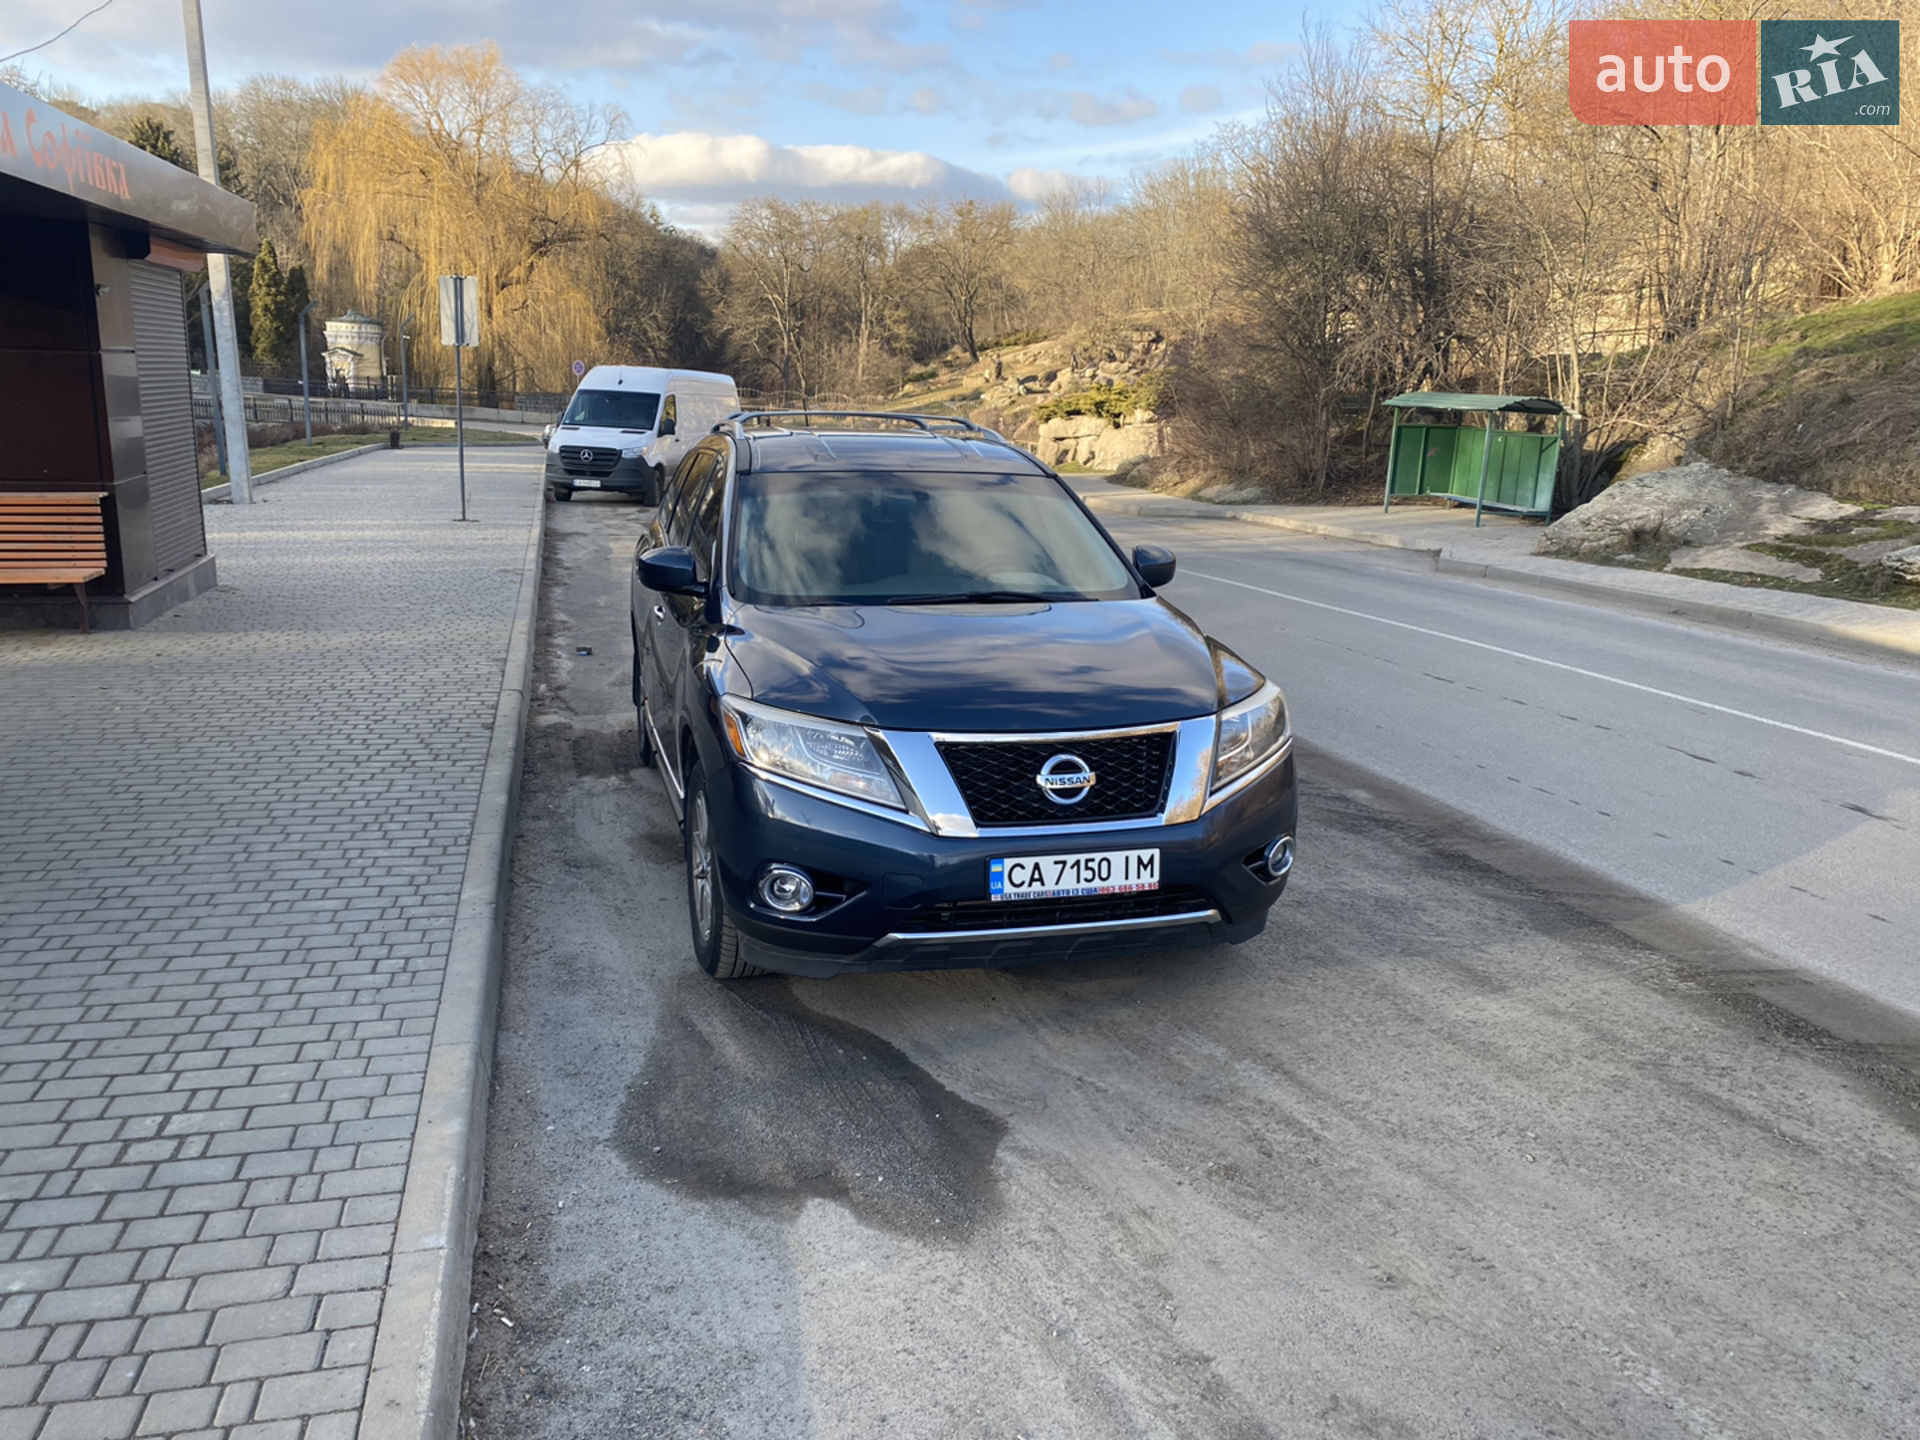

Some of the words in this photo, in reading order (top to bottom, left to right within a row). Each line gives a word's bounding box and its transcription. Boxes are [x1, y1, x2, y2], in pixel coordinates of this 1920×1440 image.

[25, 106, 131, 200] Софіївка
[1044, 776, 1091, 786] NISSAN
[1007, 861, 1046, 889] CA
[1053, 857, 1111, 886] 7150
[1125, 853, 1155, 881] IM
[991, 882, 1003, 890] UA
